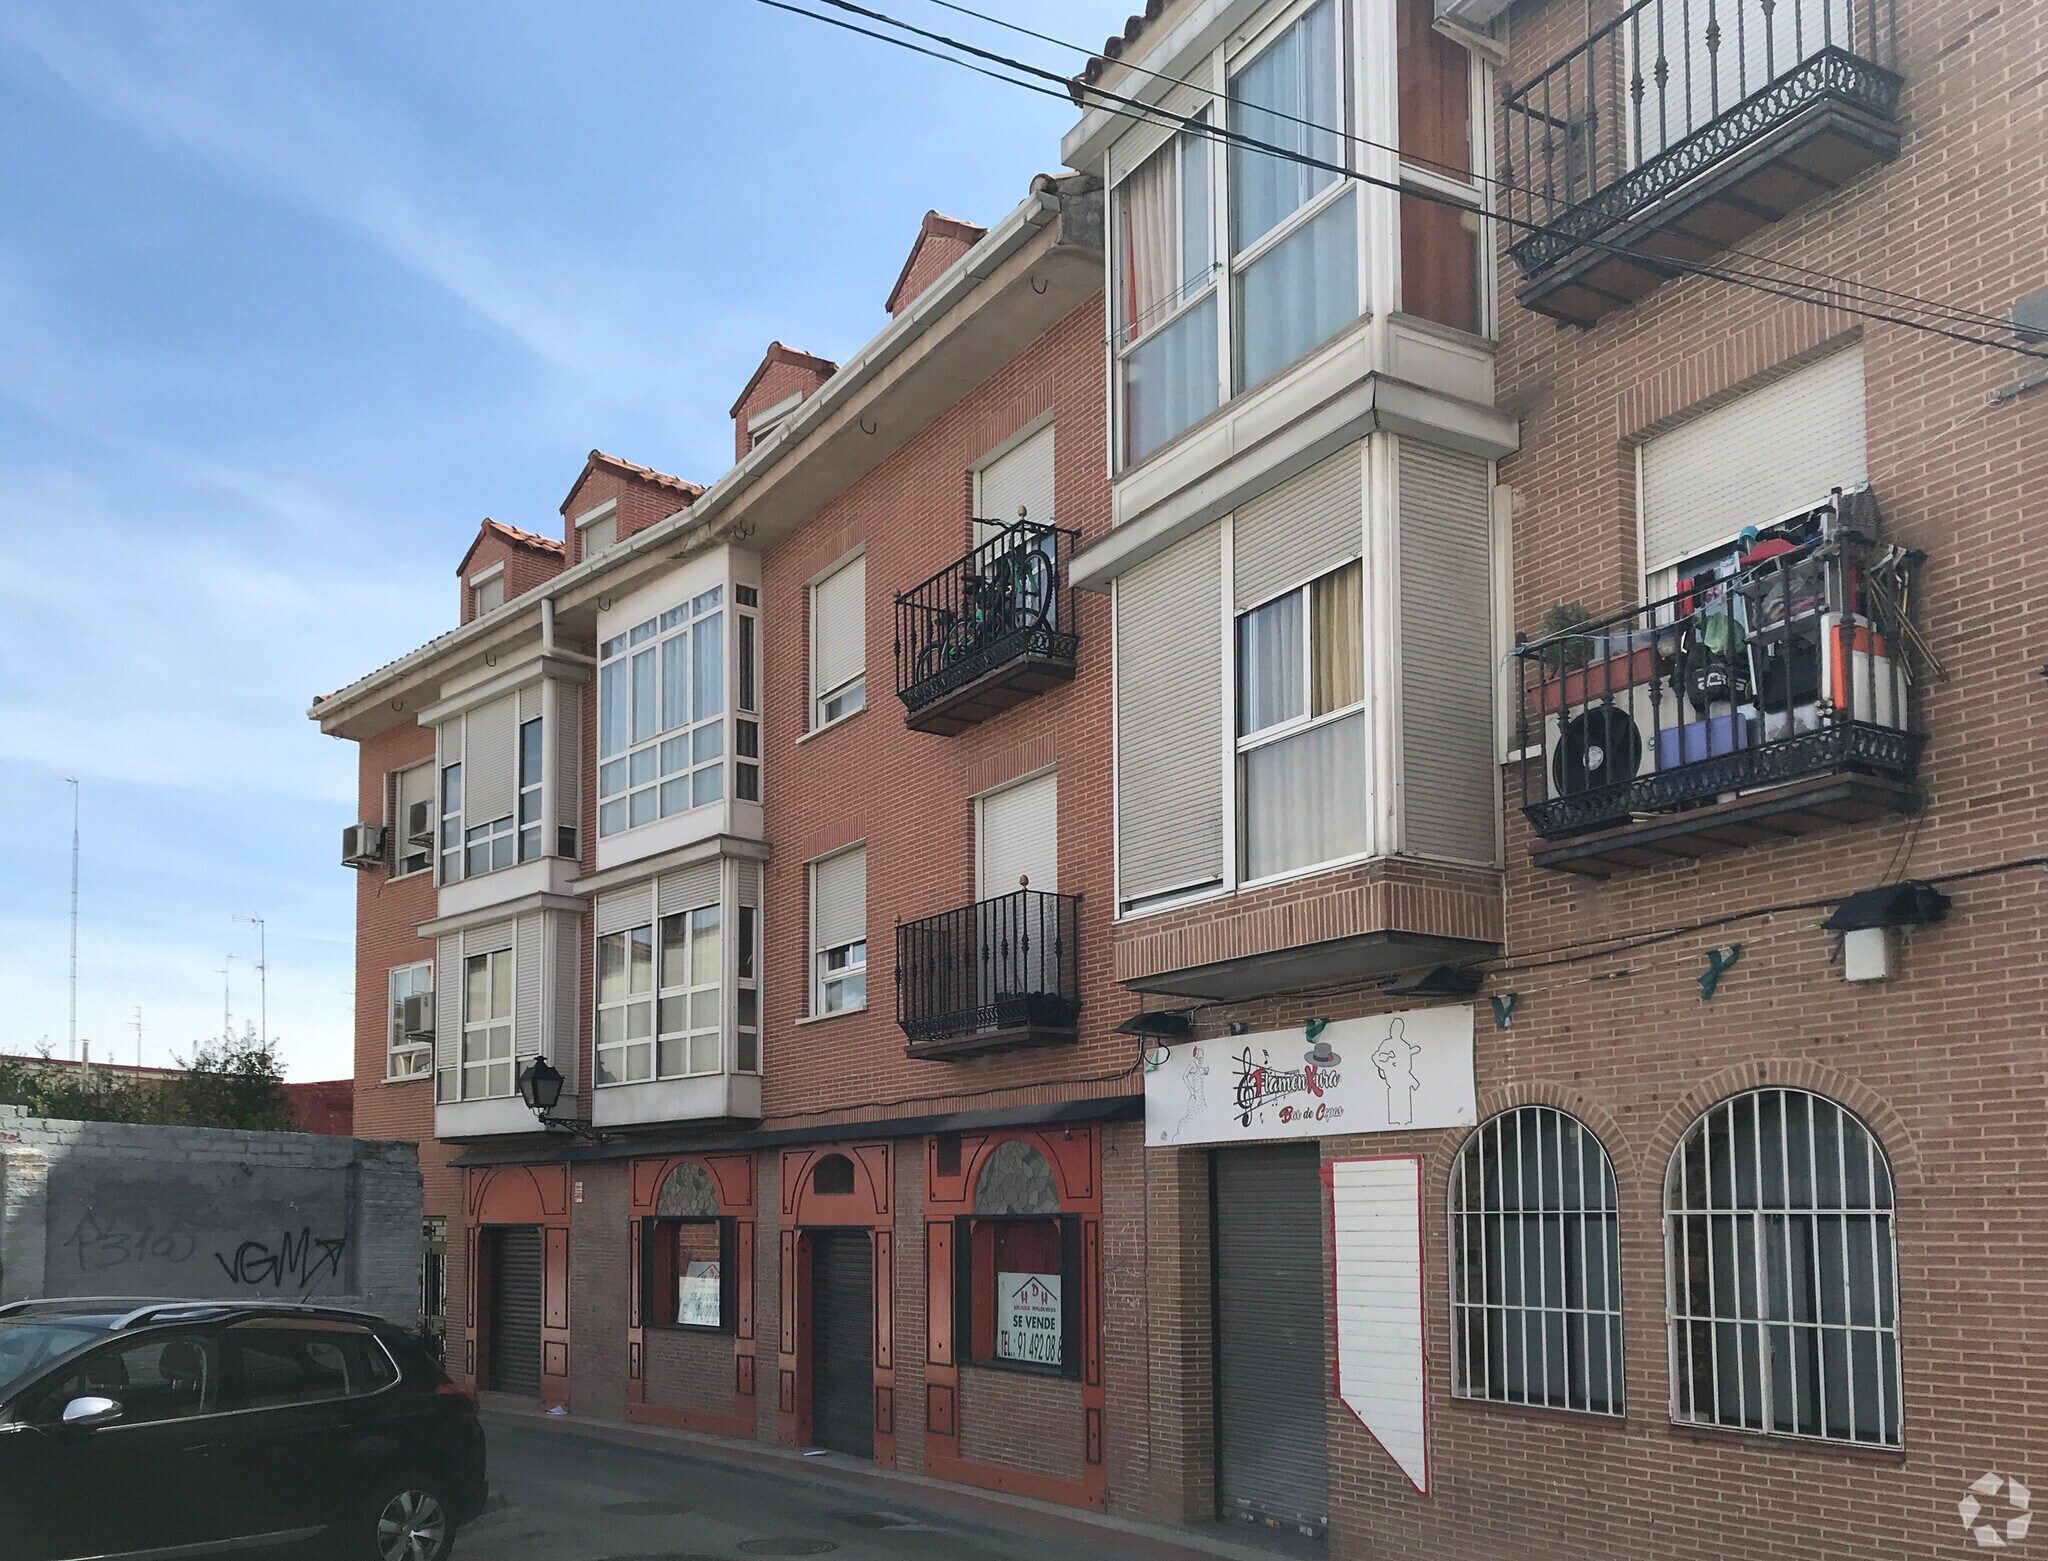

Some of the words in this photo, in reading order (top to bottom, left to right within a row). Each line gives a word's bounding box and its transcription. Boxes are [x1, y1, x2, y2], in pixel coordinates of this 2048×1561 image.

[1303, 1107, 1314, 1119] de
[1013, 1315, 1023, 1327] SE
[1025, 1316, 1056, 1330] VENDE
[1018, 1332, 1027, 1359] 91
[1029, 1333, 1045, 1361] 492
[1045, 1334, 1056, 1362] 08
